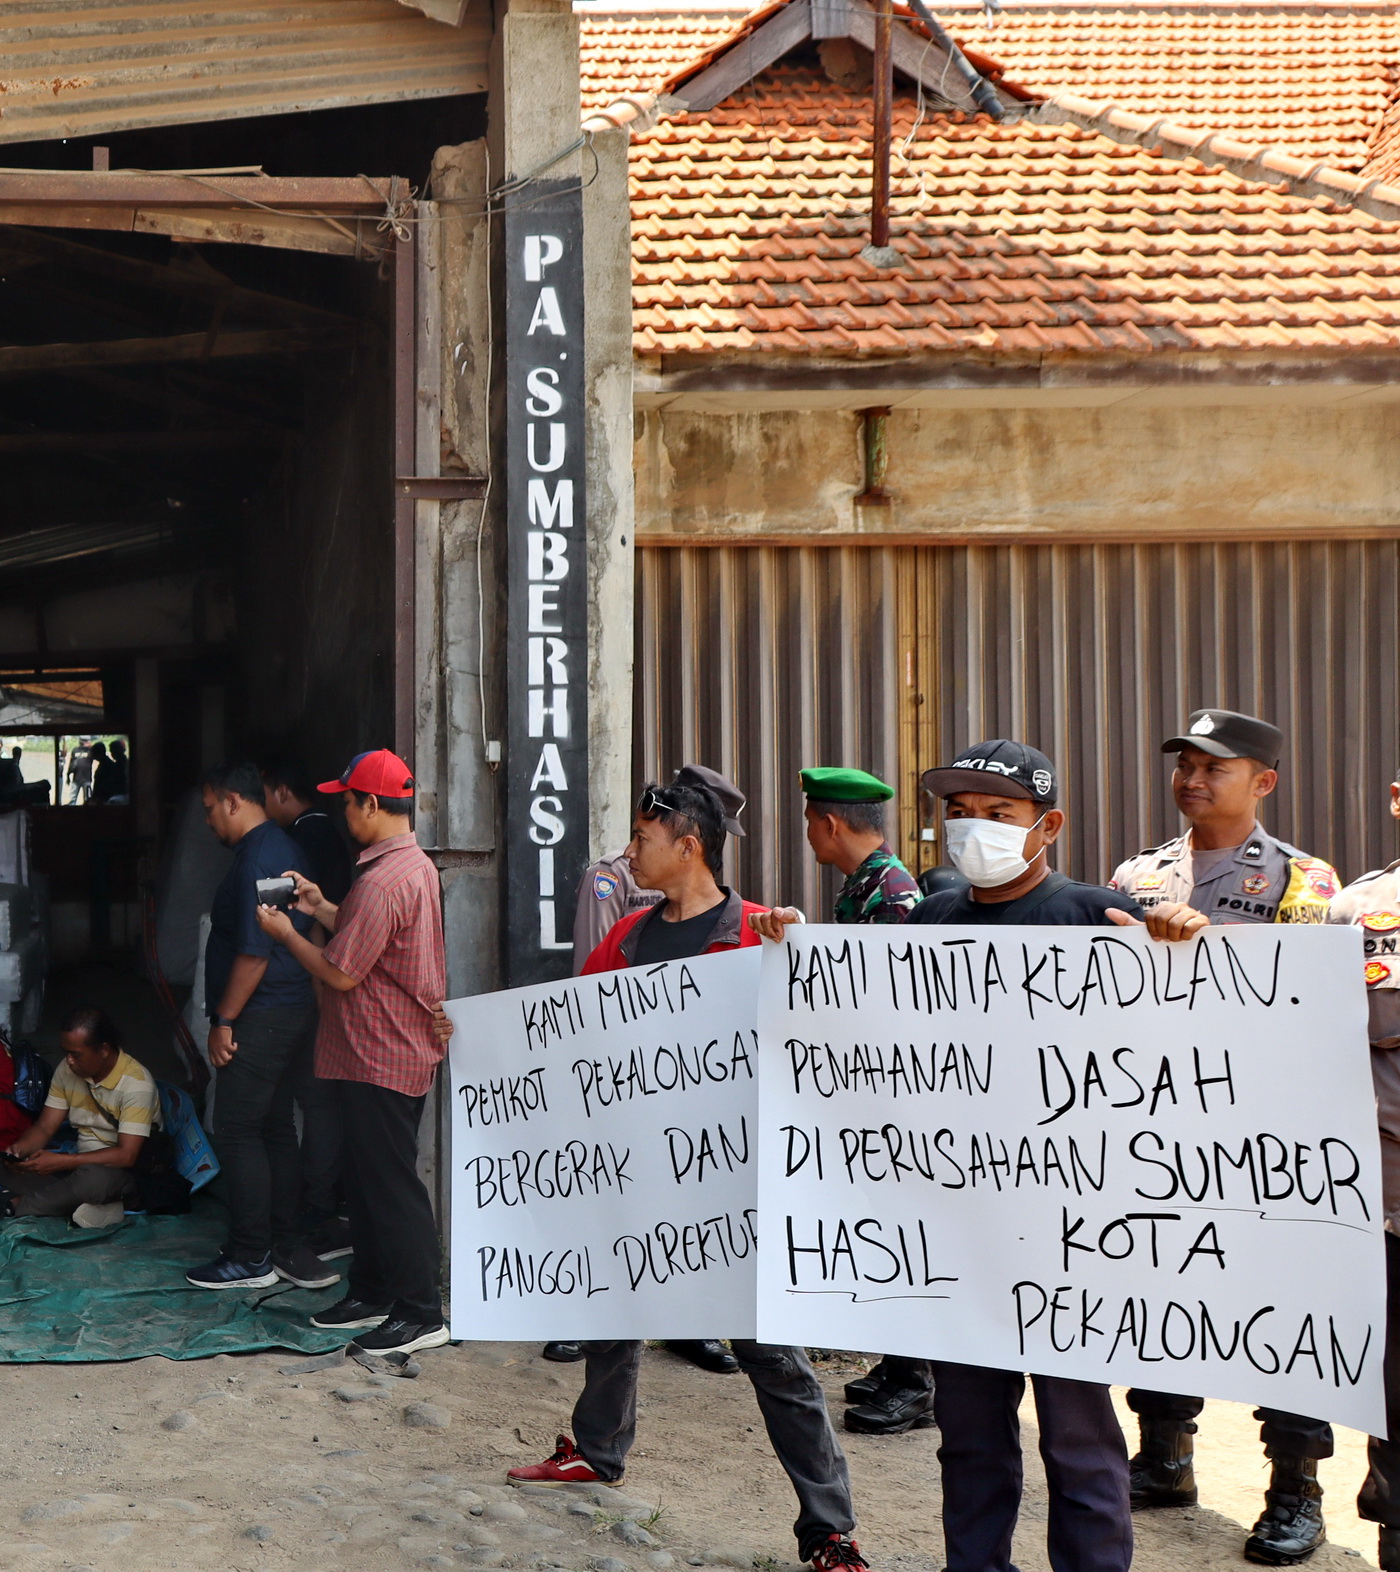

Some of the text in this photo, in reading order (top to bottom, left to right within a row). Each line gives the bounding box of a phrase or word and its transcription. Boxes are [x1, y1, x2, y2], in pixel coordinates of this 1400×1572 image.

[1217, 897, 1275, 918] POLRI
[521, 963, 701, 1052] KAMI MINTA
[786, 933, 1300, 1021] KAMI MINTA KEADILAN.
[458, 1029, 758, 1129] PEMKOT PEKALONGA
[783, 1038, 1236, 1126] PENAHANAN IJASAH
[464, 1114, 749, 1210] BERGERAK DAN
[781, 1120, 1372, 1220] DI PERUSAHAAN SUMBER
[476, 1245, 610, 1302] PANGGIL
[785, 1205, 1228, 1287] HASIL KOTA
[1012, 1281, 1371, 1388] PEKALONGAN
